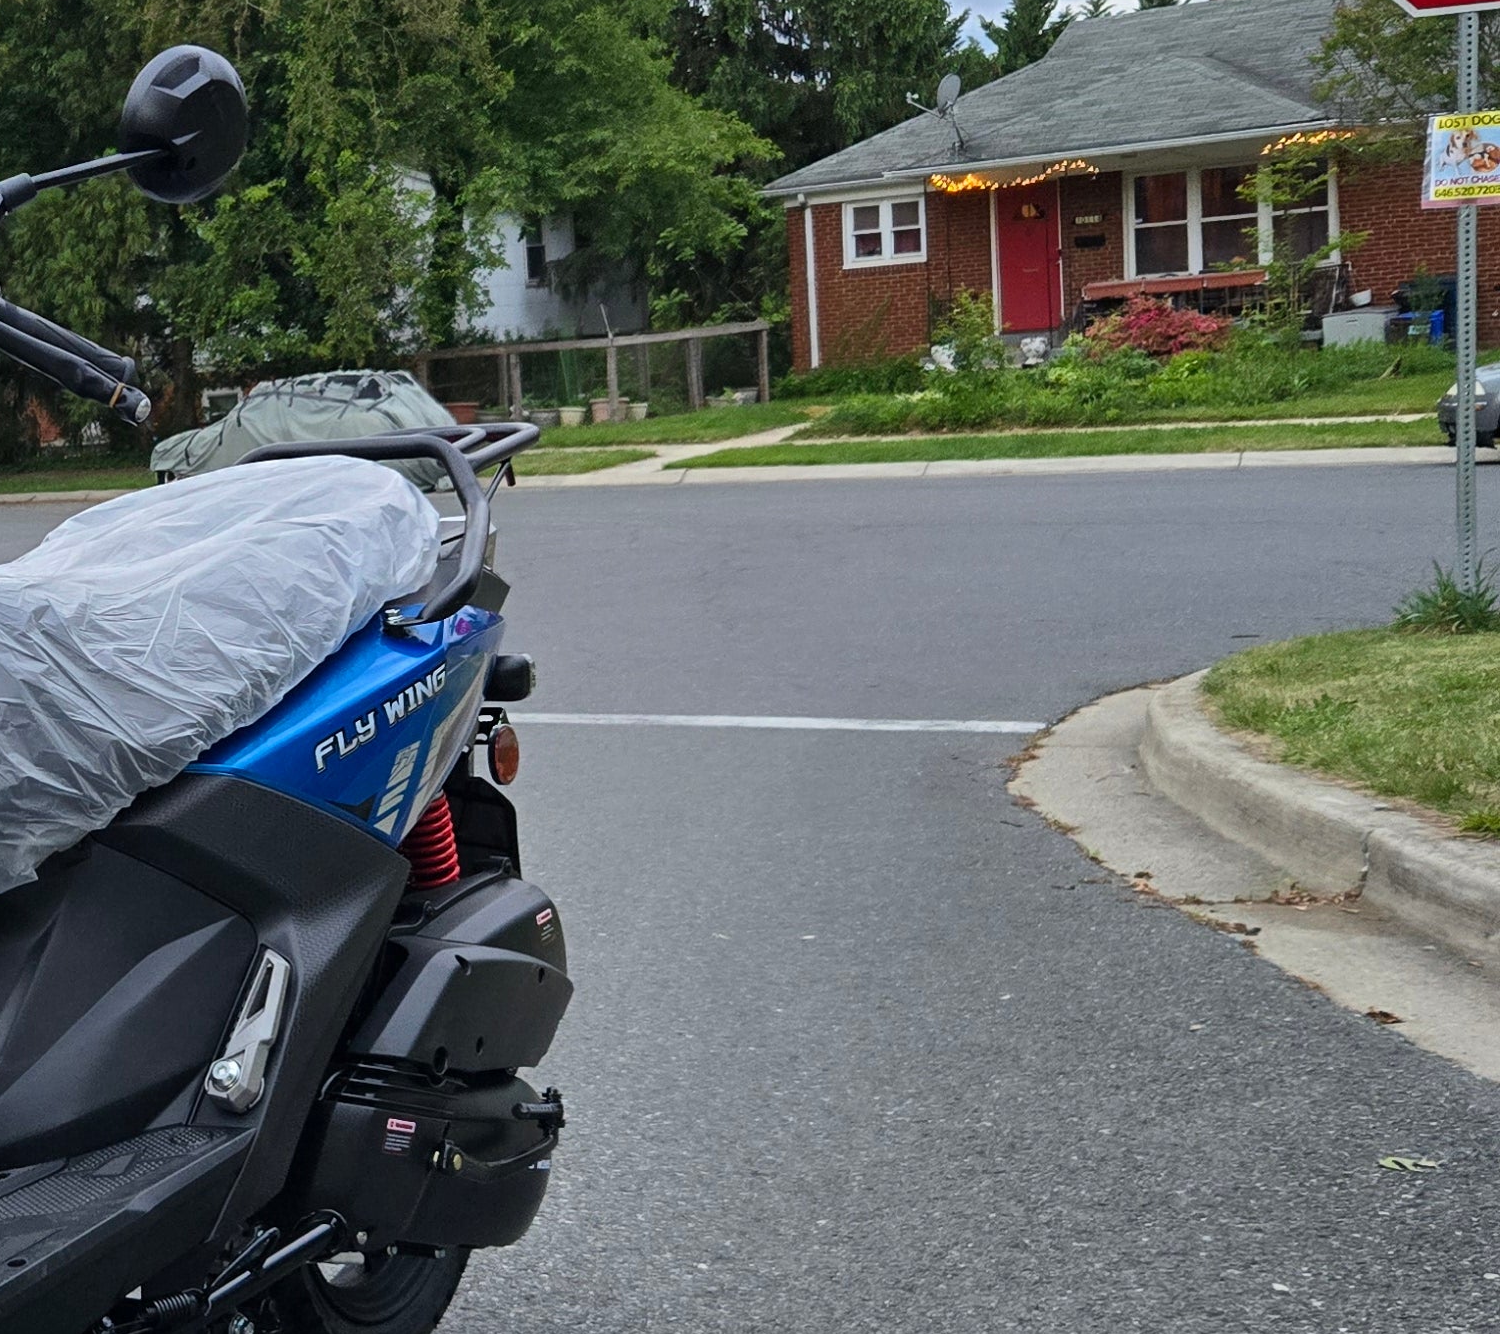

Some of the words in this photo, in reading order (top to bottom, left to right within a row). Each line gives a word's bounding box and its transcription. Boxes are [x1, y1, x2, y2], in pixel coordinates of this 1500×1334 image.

[1438, 116, 1469, 129] LOST
[1471, 114, 1500, 126] DOG
[1434, 178, 1448, 187] DO
[1450, 176, 1469, 185] NOT
[314, 710, 376, 773] FLY
[382, 662, 447, 728] WING
